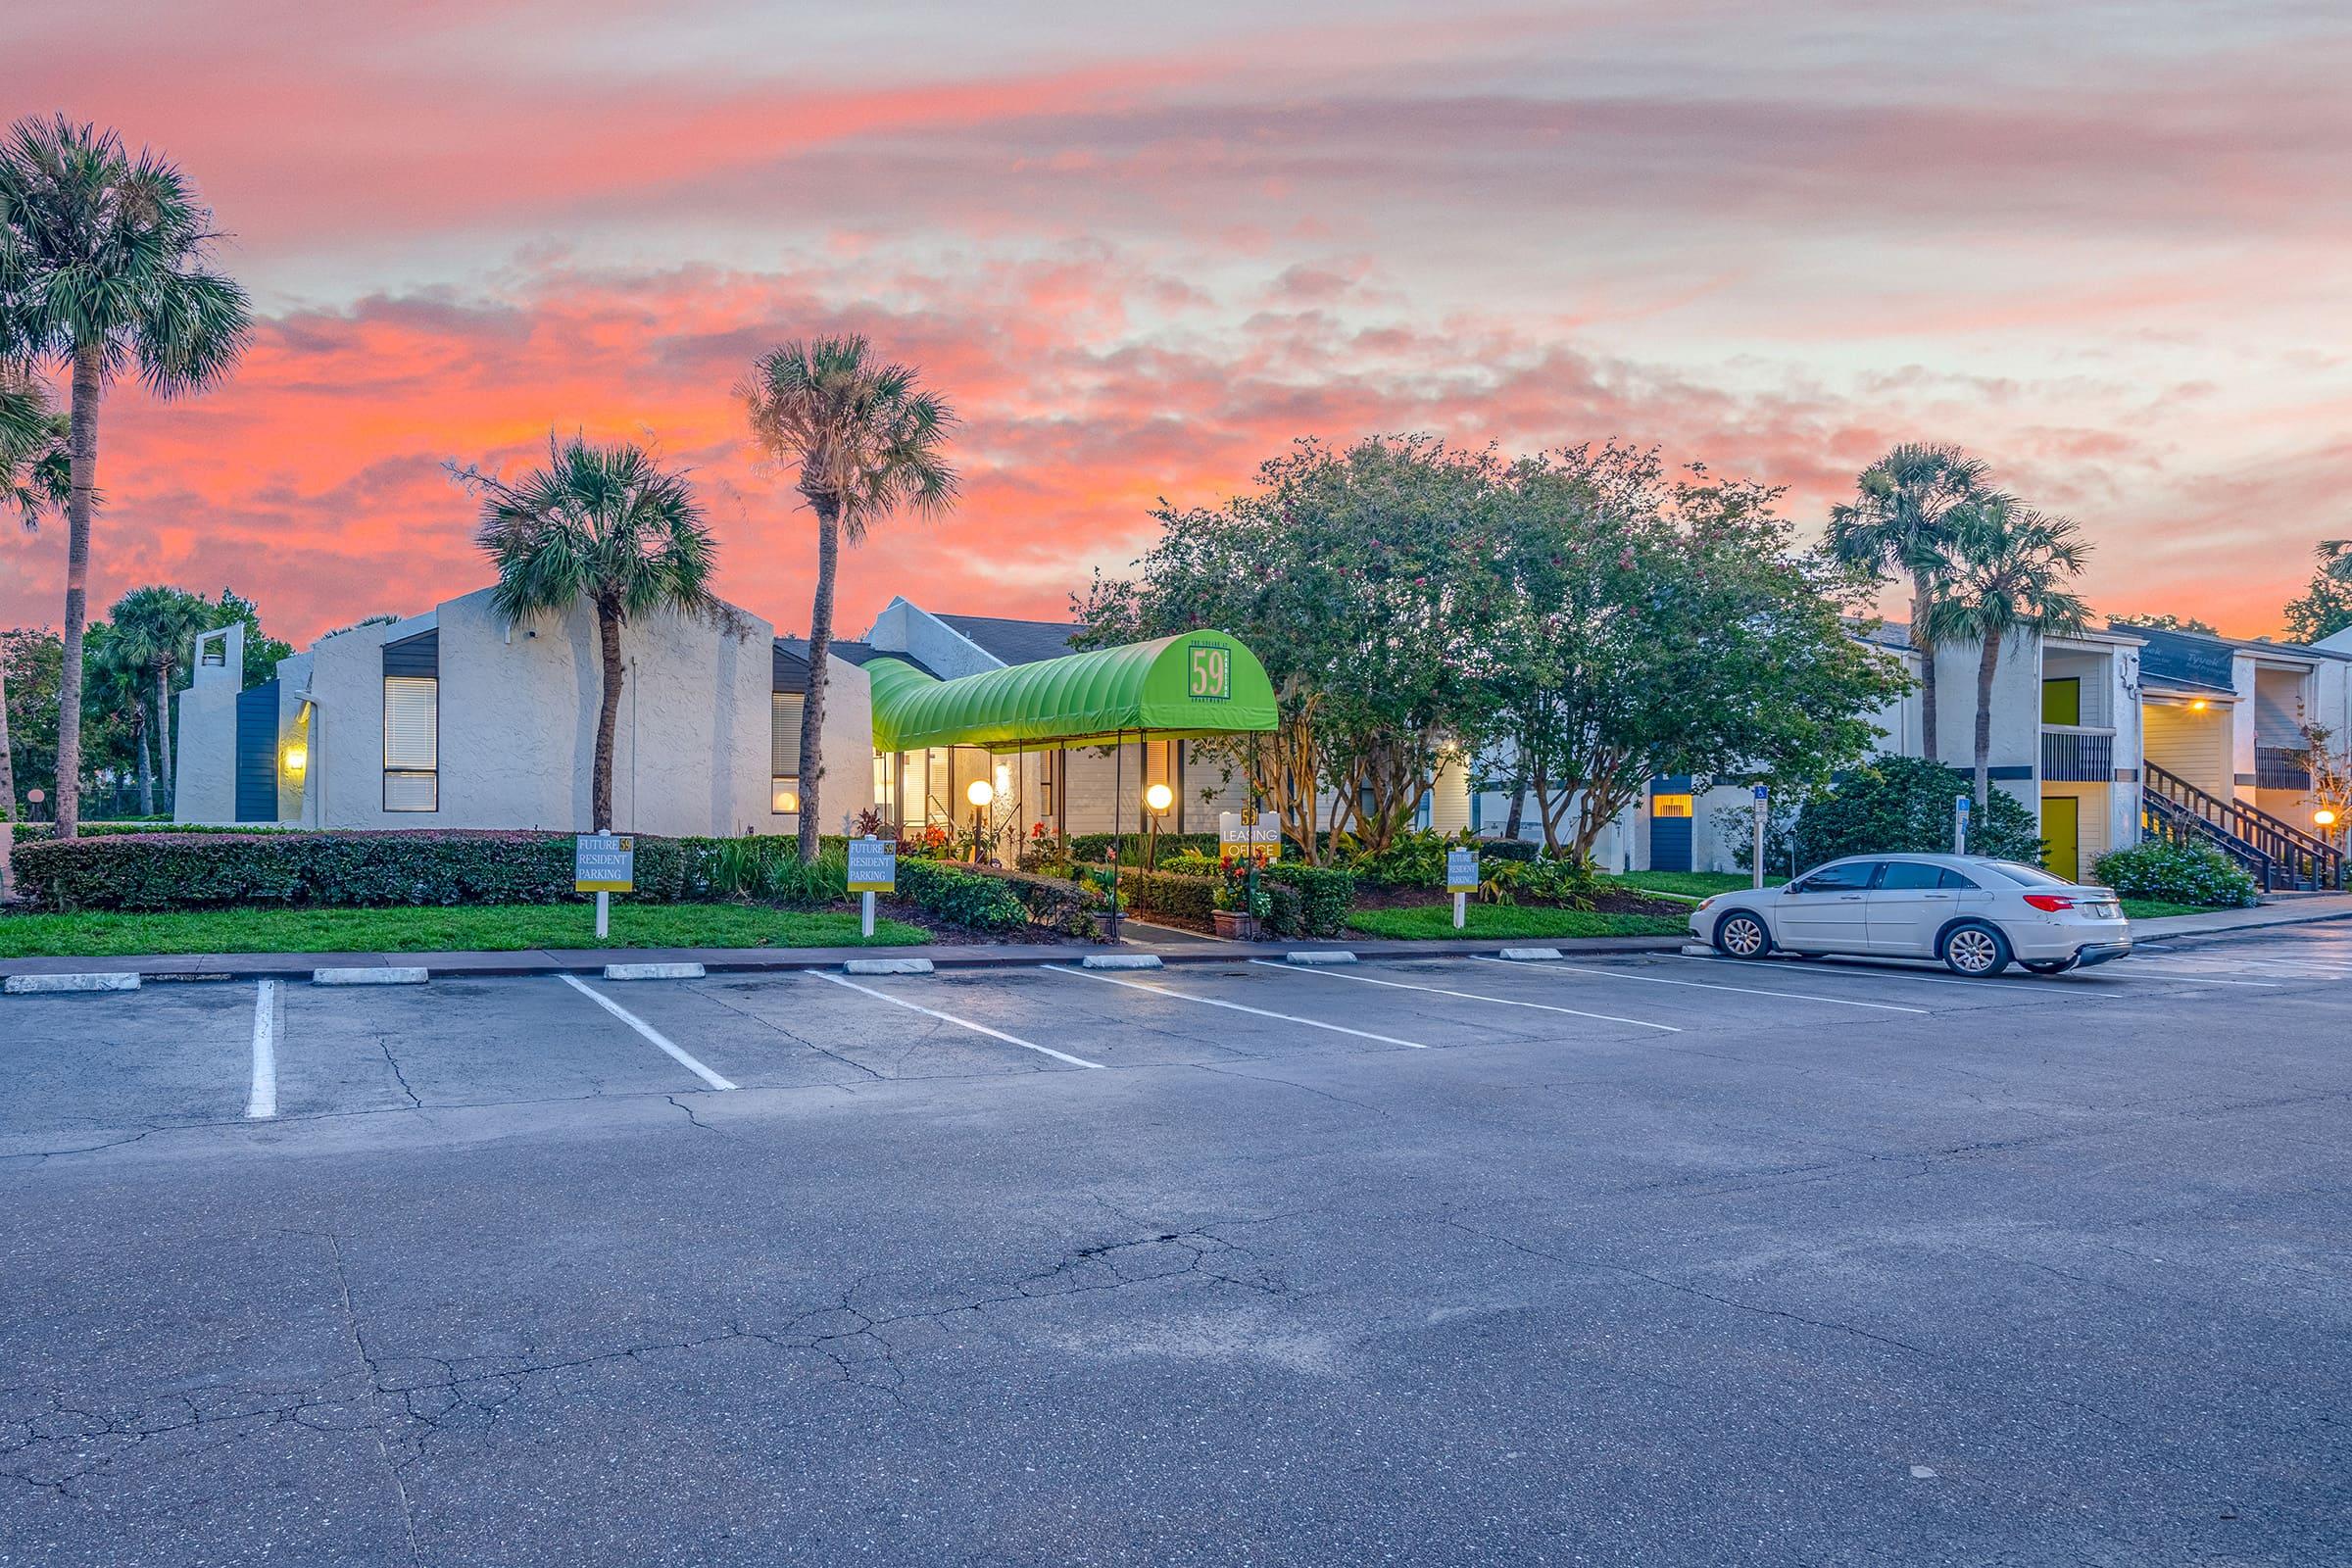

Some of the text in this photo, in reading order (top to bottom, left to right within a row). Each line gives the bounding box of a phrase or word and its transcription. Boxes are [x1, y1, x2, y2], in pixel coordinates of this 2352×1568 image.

[2186, 654, 2220, 668] Tyvek
[1193, 650, 1224, 694] 59
[1223, 829, 1278, 842] LEASING
[579, 838, 631, 851] FUTURE 59
[851, 843, 883, 854] FUTURE
[579, 854, 627, 864] RESIDENT
[850, 857, 890, 867] RESIDENT
[578, 868, 621, 880] PARKING
[850, 870, 886, 881] PARKING
